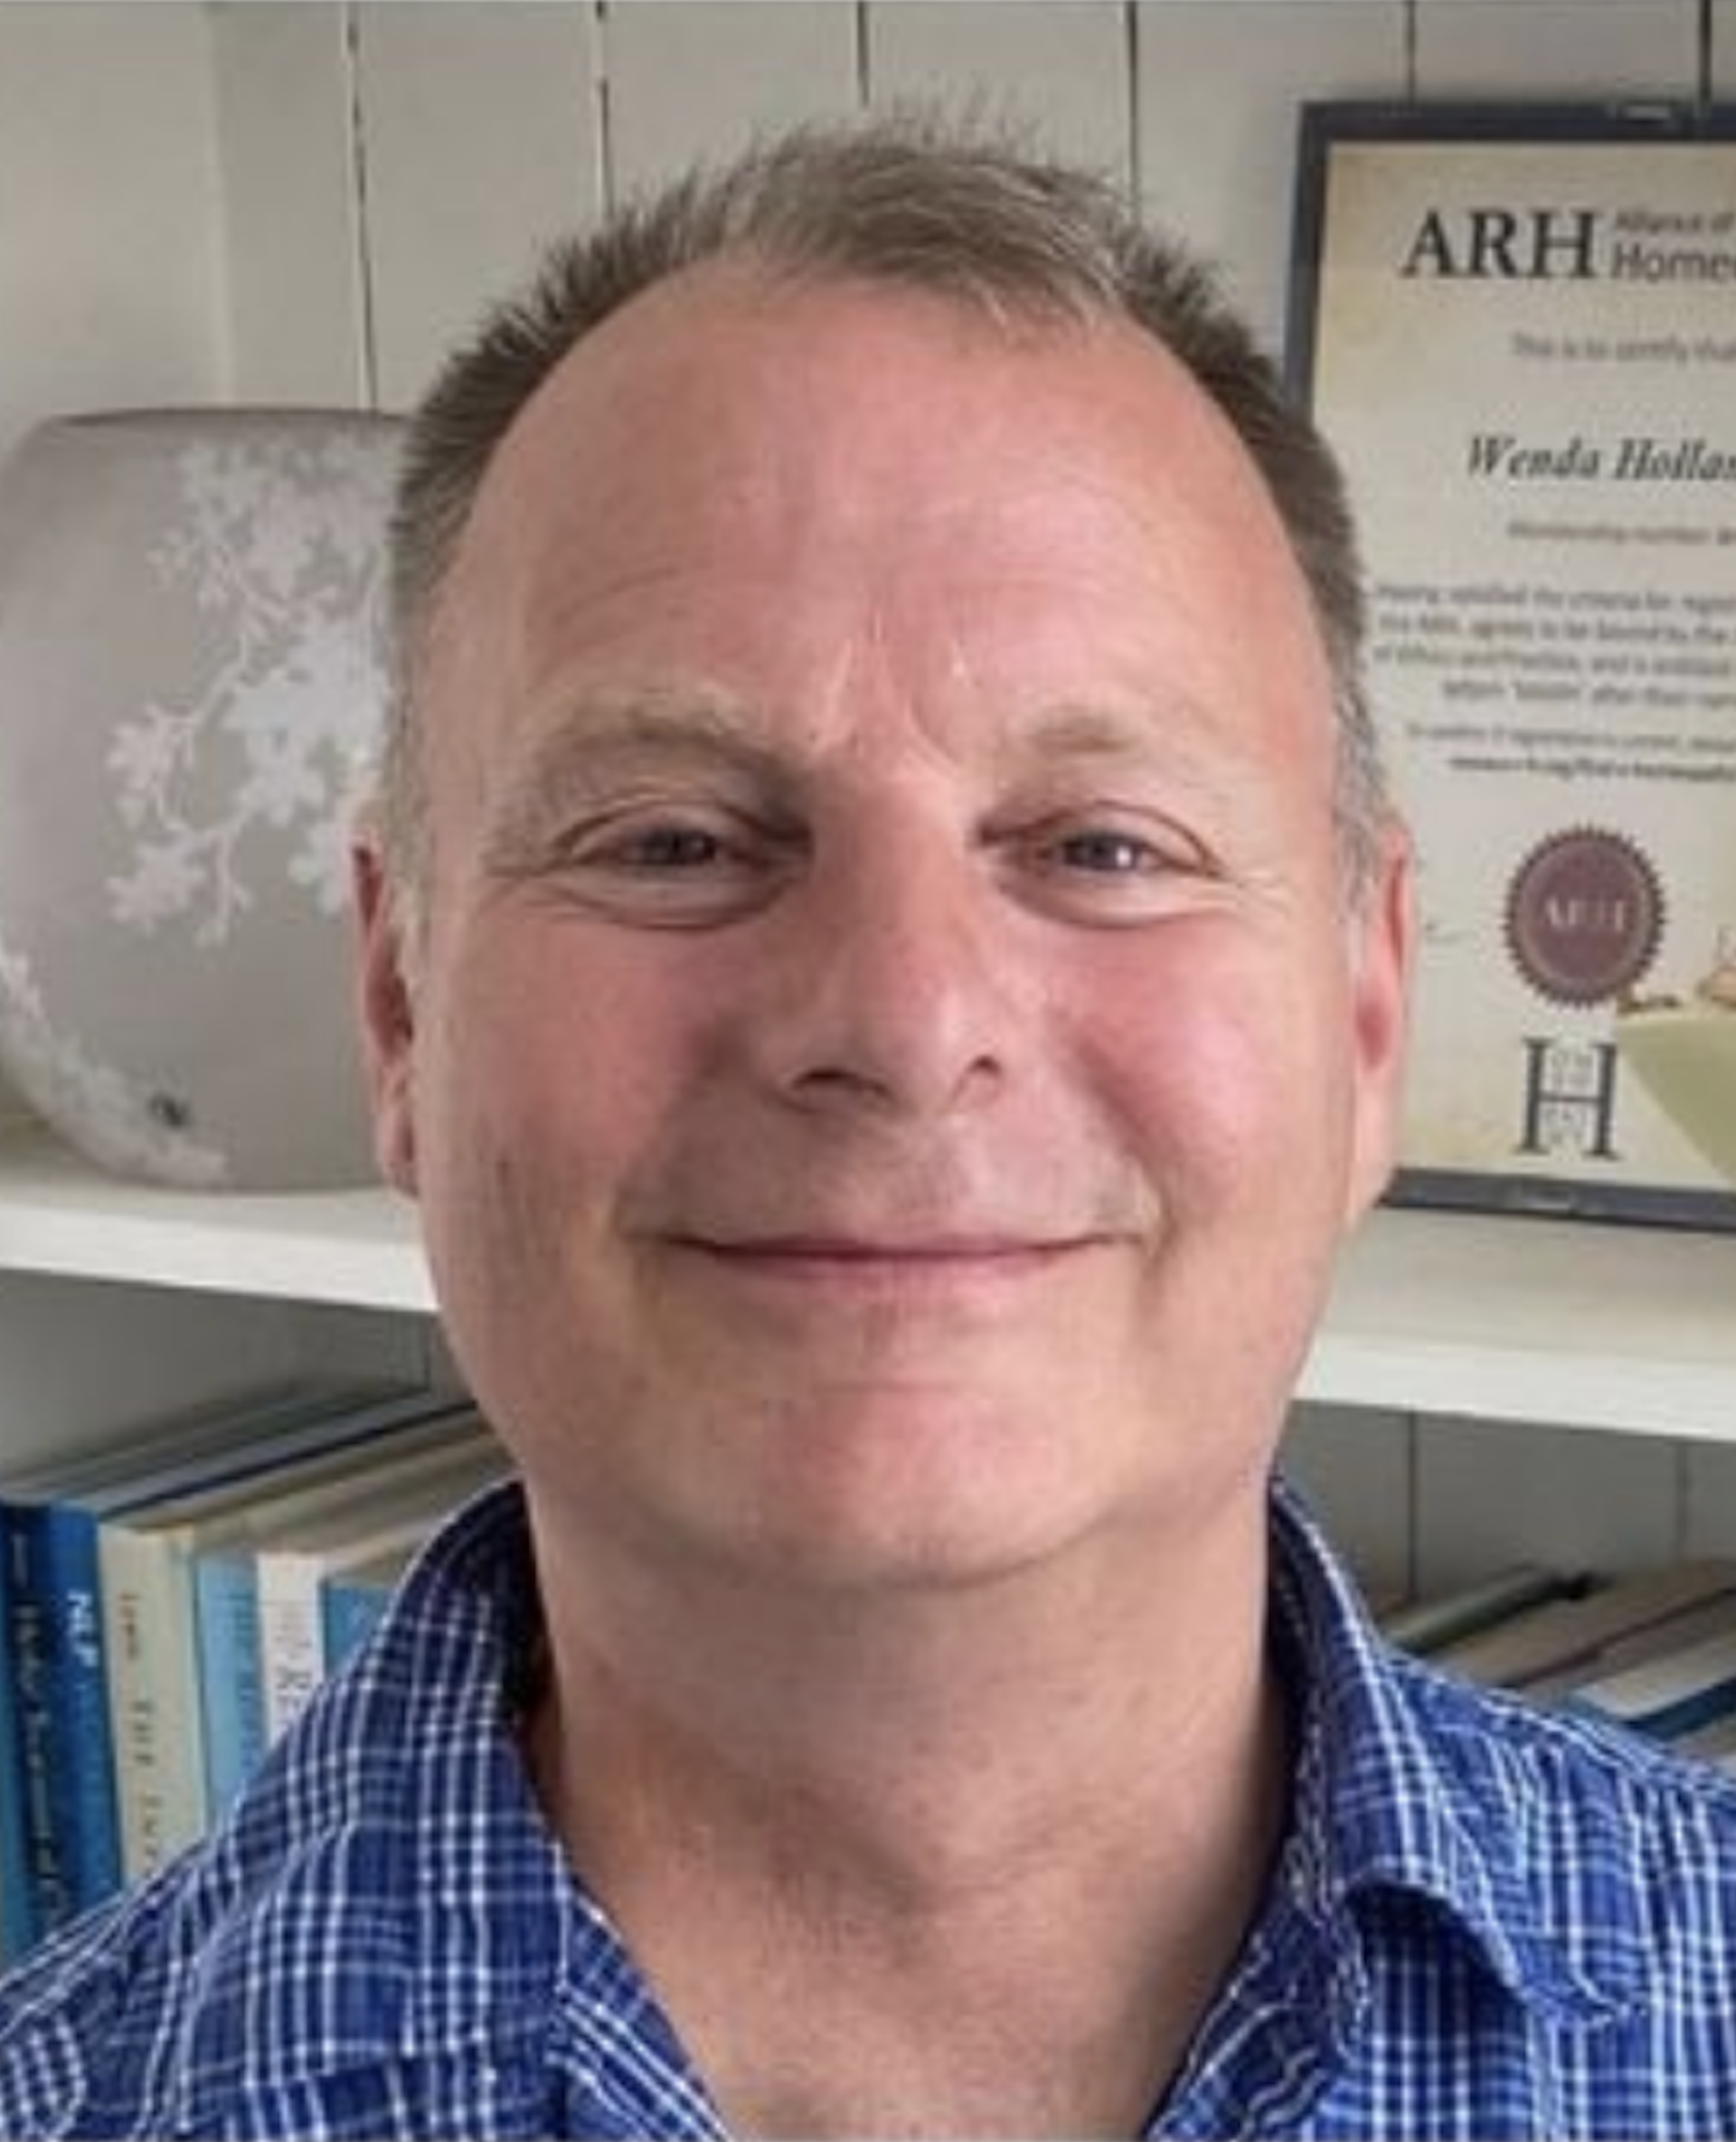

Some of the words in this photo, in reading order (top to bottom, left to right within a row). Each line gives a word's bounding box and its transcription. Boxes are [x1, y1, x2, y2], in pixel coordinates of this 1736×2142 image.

[1402, 207, 1602, 281] ARH
[1612, 241, 1736, 285] Home
[1467, 436, 1599, 477] Wenda
